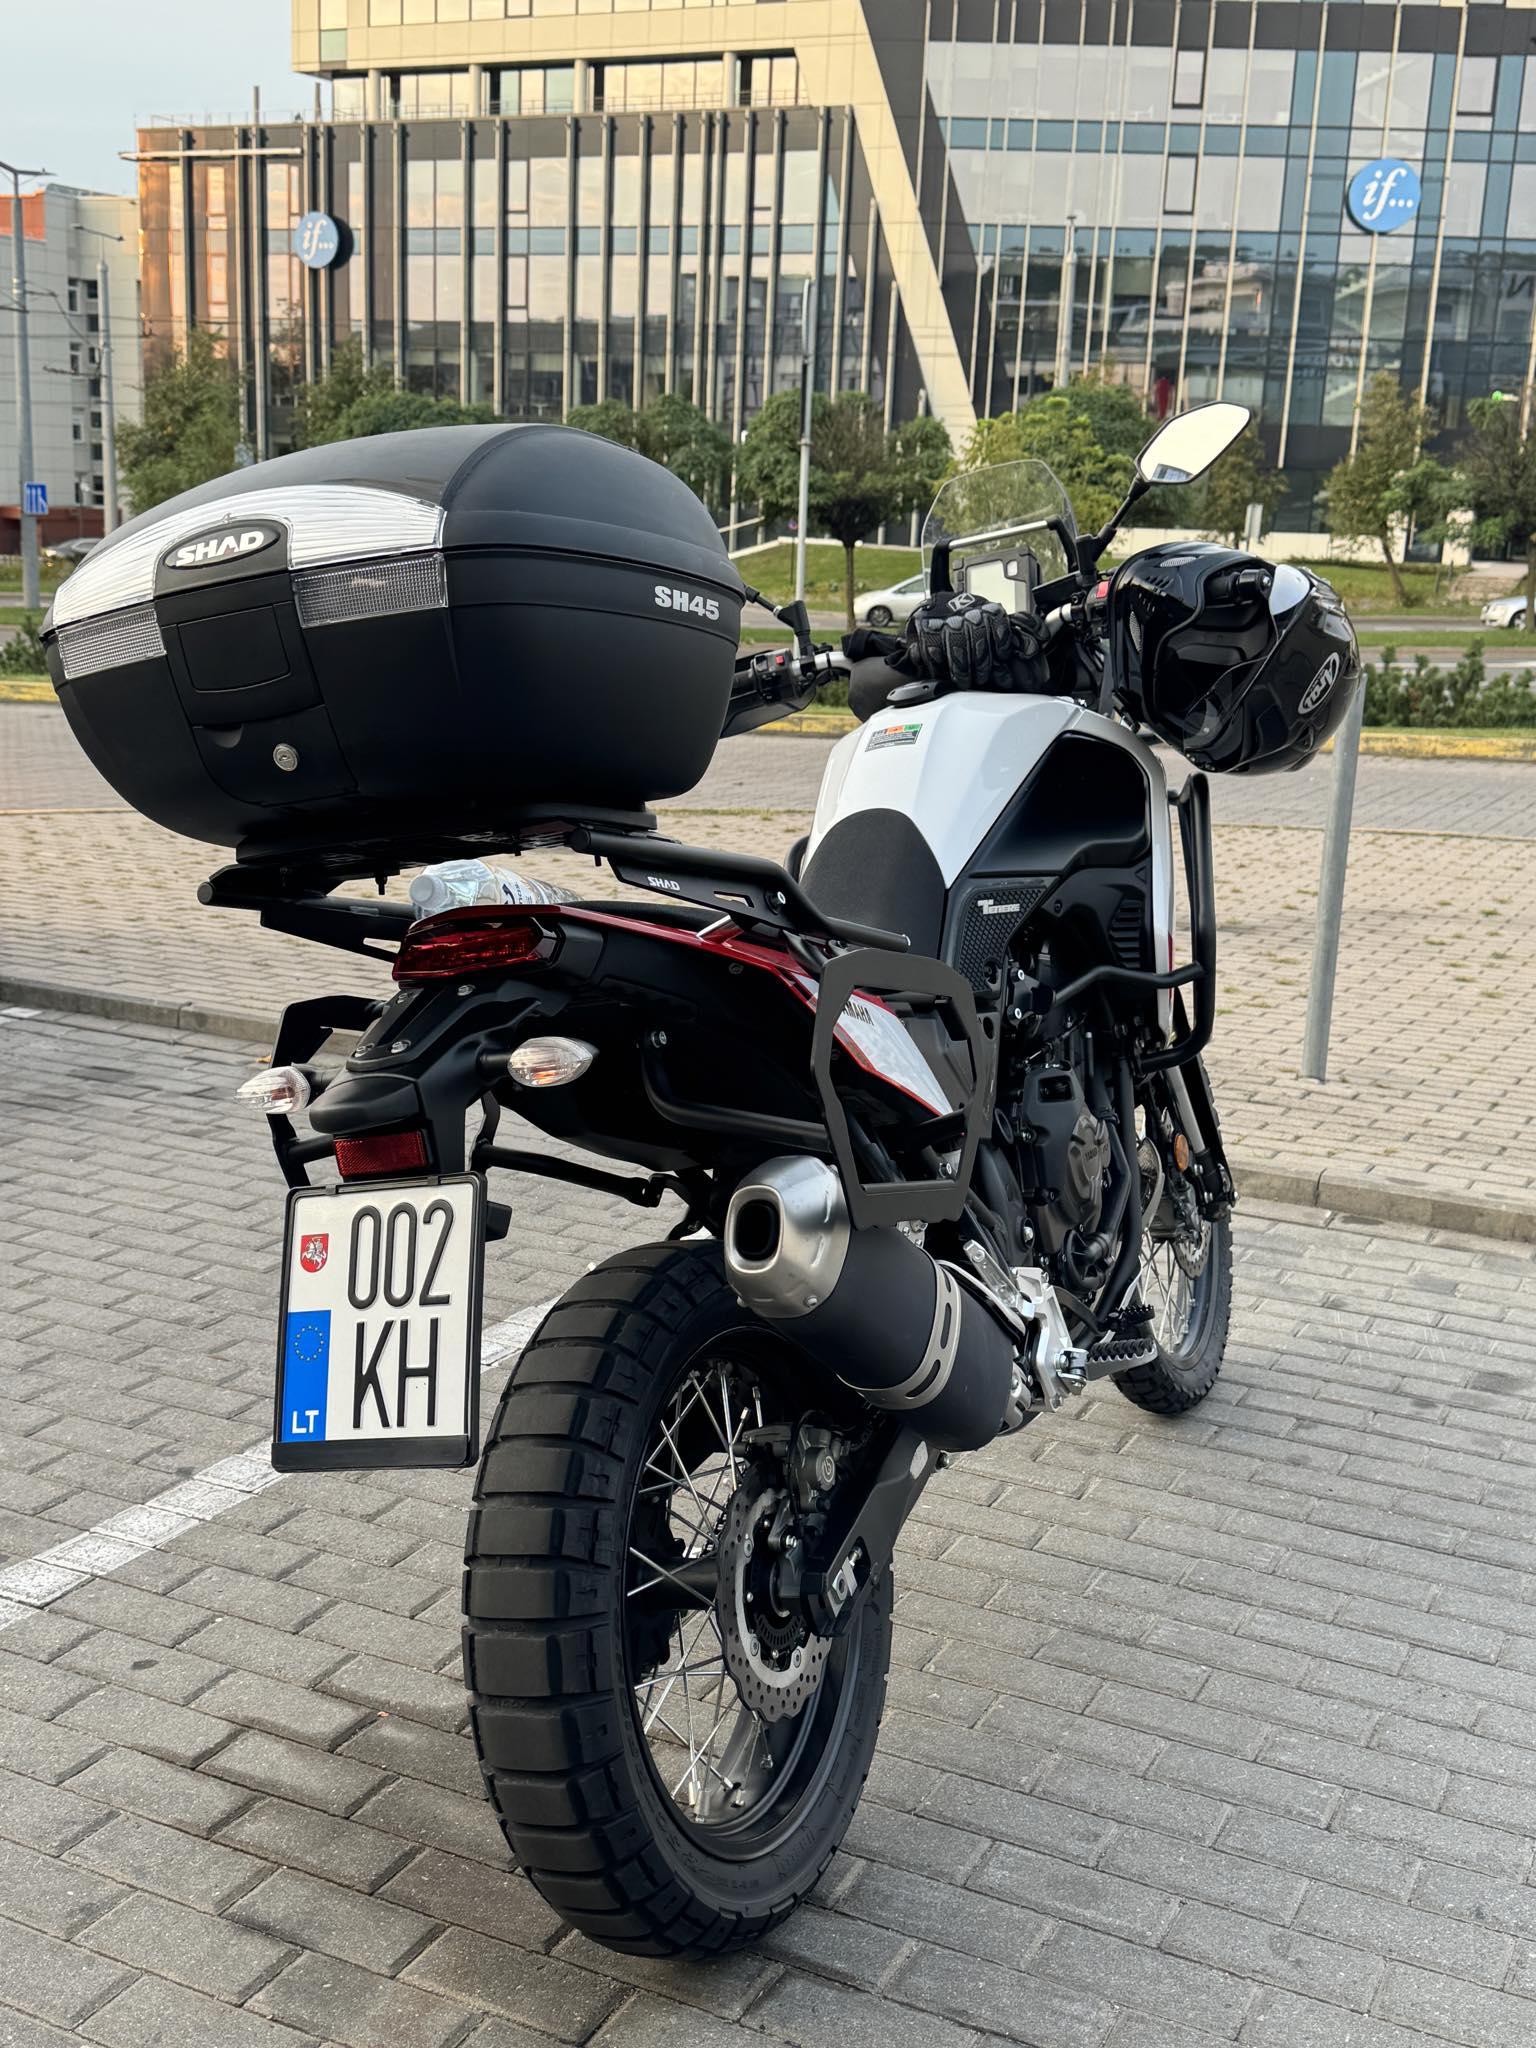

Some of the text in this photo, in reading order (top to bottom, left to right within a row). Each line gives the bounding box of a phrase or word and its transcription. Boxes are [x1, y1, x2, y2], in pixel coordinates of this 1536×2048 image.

[176, 530, 264, 567] SHAD
[654, 585, 720, 621] SH45
[647, 876, 681, 891] SHAD
[348, 1198, 454, 1310] 002
[352, 1316, 441, 1430] KH
[291, 1409, 320, 1435] LT
